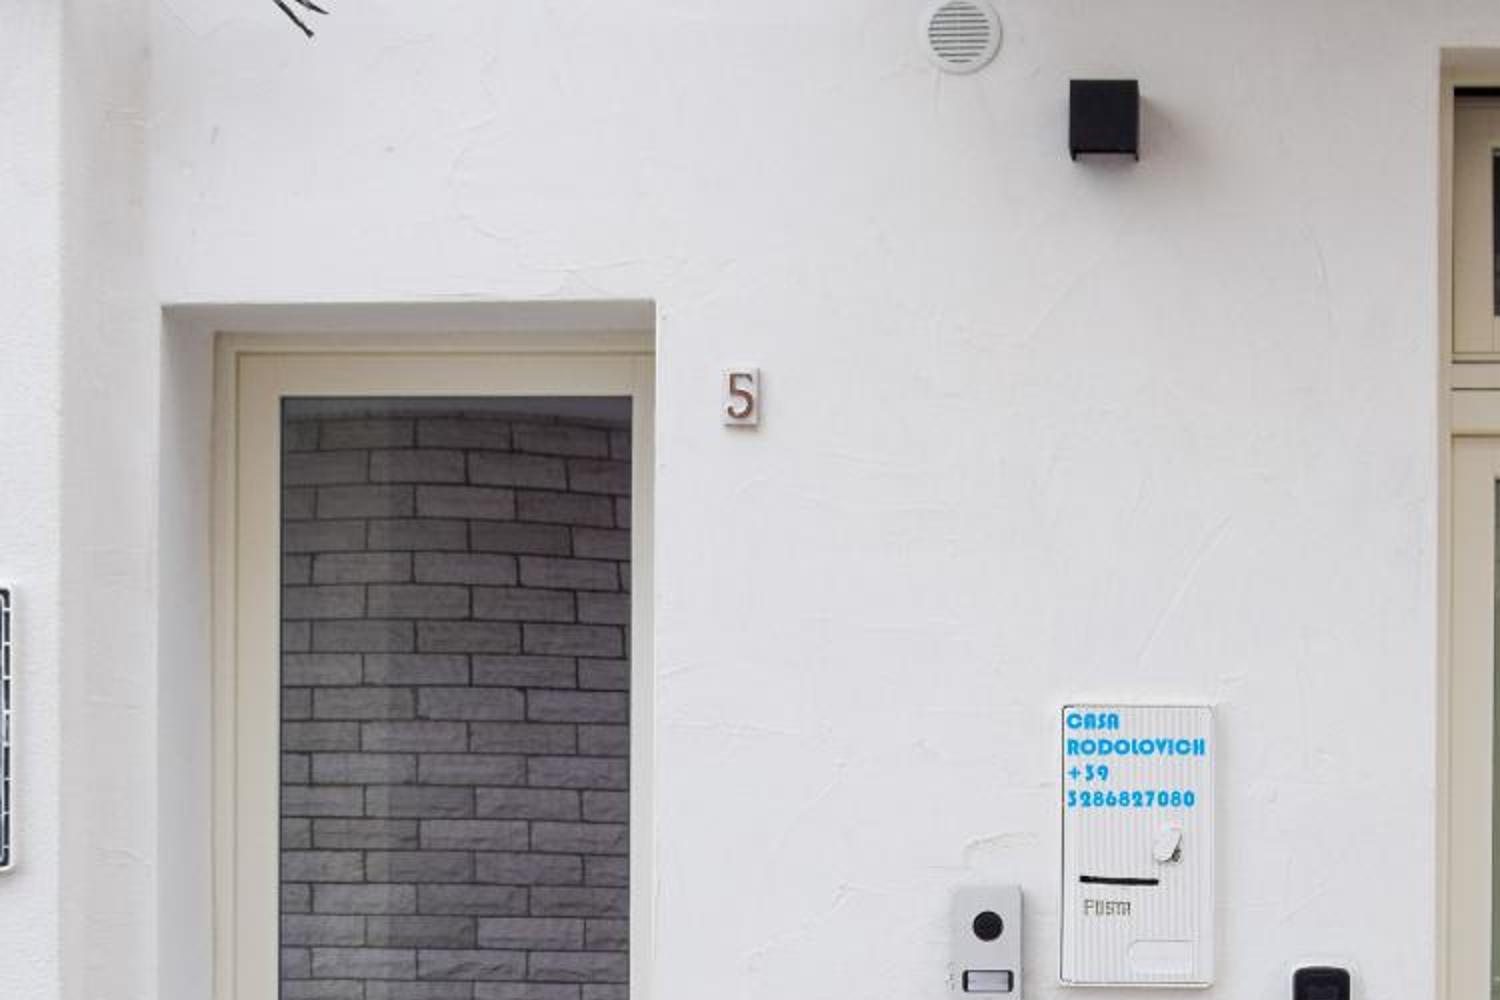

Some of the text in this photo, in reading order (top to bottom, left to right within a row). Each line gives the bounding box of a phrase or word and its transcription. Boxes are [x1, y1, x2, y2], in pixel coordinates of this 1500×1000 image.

[727, 373, 753, 419] 5
[1066, 712, 1120, 730] CASA
[1066, 738, 1206, 756] RODOLOVICH
[1067, 763, 1110, 782] +39
[1066, 789, 1196, 808] 3286827080
